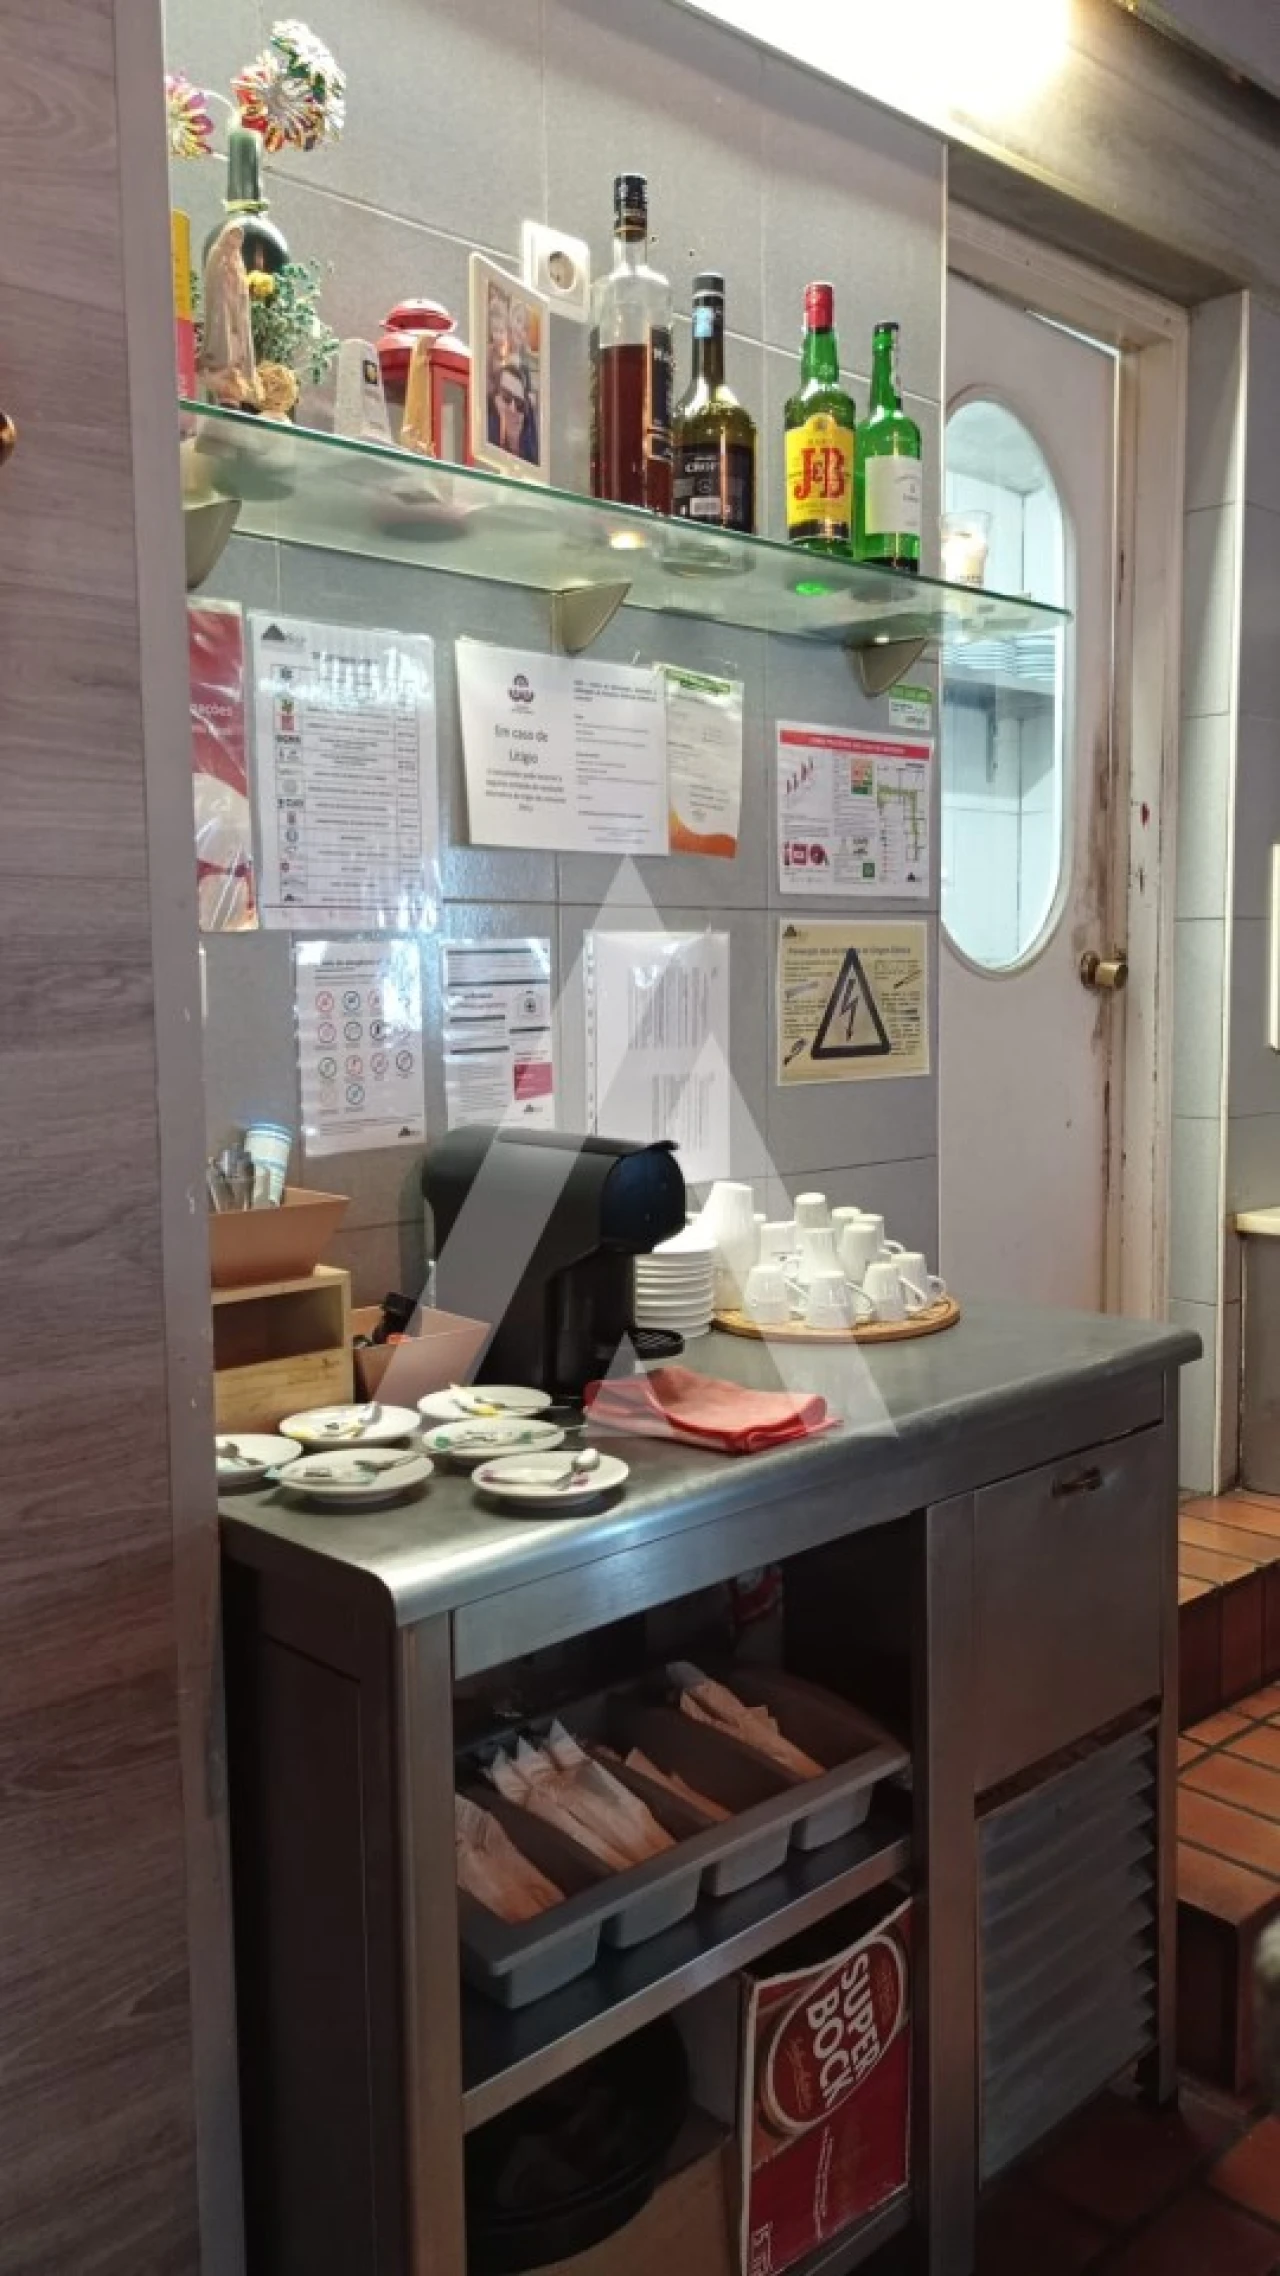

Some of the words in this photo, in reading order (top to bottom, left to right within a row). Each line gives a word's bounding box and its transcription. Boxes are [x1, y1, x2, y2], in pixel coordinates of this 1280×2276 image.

[794, 447, 846, 500] J&B
[495, 724, 510, 738] Em
[511, 729, 534, 741] caso
[535, 729, 548, 742] de
[807, 1986, 854, 2109] BOCK
[841, 1952, 881, 2082] SUPER
